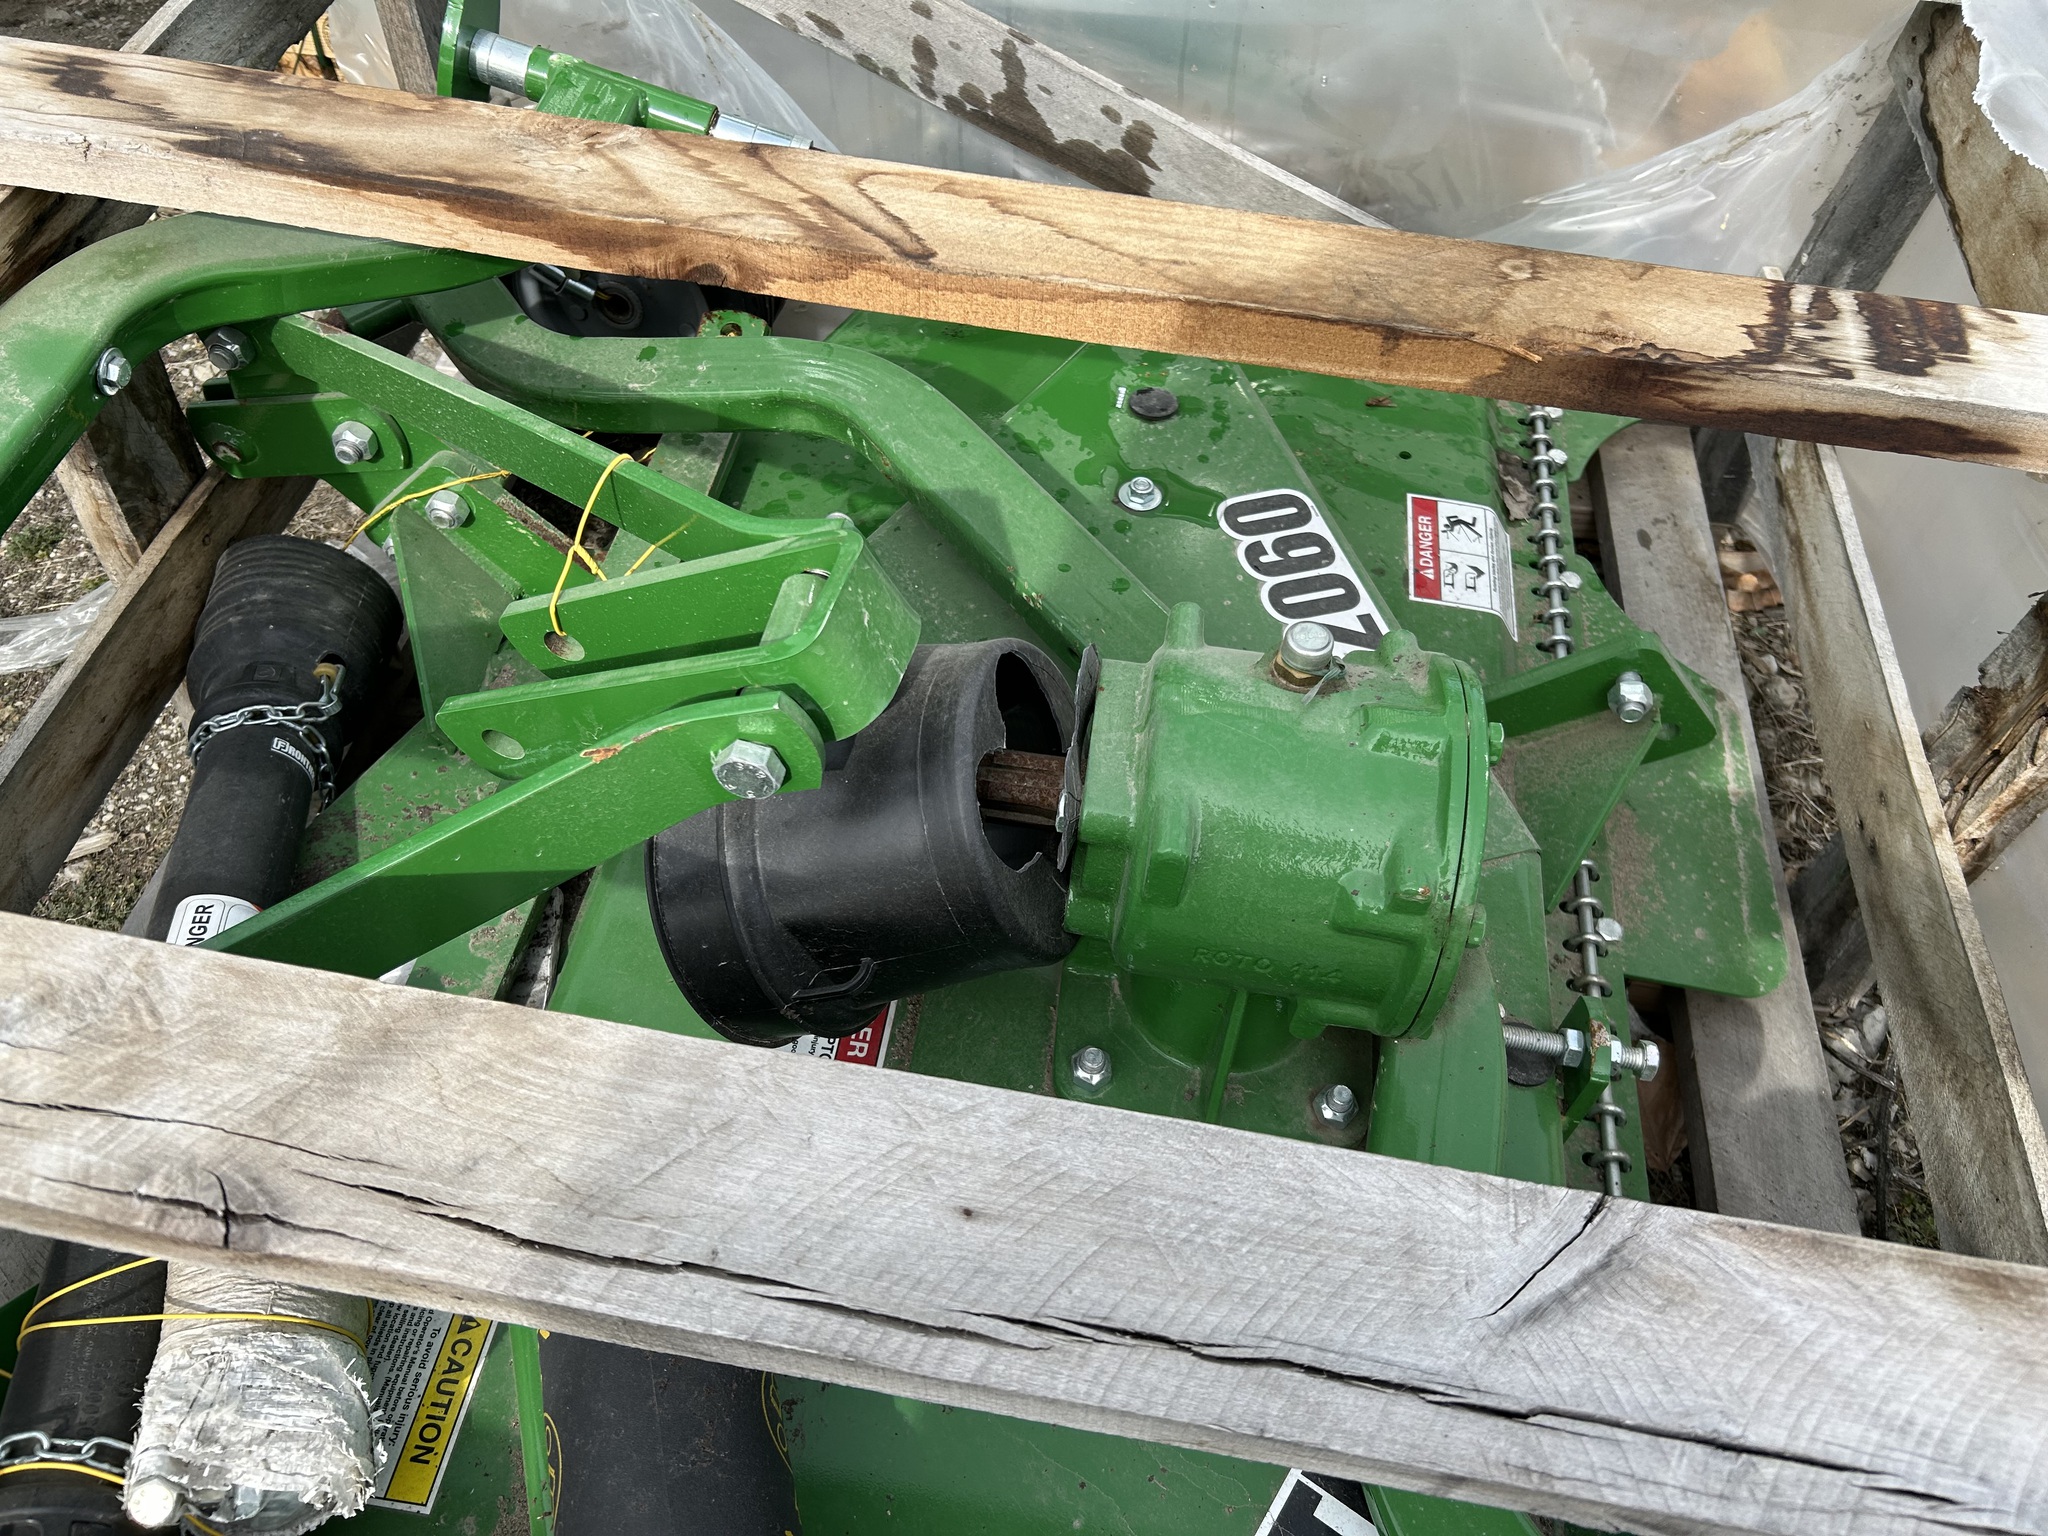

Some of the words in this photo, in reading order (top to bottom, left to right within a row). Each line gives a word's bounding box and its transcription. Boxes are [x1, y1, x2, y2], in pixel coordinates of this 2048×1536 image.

[1417, 515, 1434, 567] DANGER
[1192, 947, 1274, 974] ROTO
[373, 1320, 387, 1346] shields
[383, 1312, 400, 1342] location
[394, 1309, 408, 1333] selling
[406, 1312, 415, 1326] and
[411, 1328, 417, 1336] or
[429, 1327, 441, 1338] To
[383, 1334, 398, 1362] dealer).
[412, 1315, 432, 1354] Operator's
[376, 1344, 386, 1358] and
[387, 1328, 410, 1374] instructions.
[396, 1338, 414, 1371] repairing
[418, 1341, 433, 1369] avoid
[400, 1356, 416, 1384] Manual
[390, 1386, 405, 1411] before
[402, 1371, 421, 1410] serious
[410, 1339, 471, 1463] CAUTION
[378, 1414, 393, 1441] oprat
[388, 1413, 408, 1446] injury:
